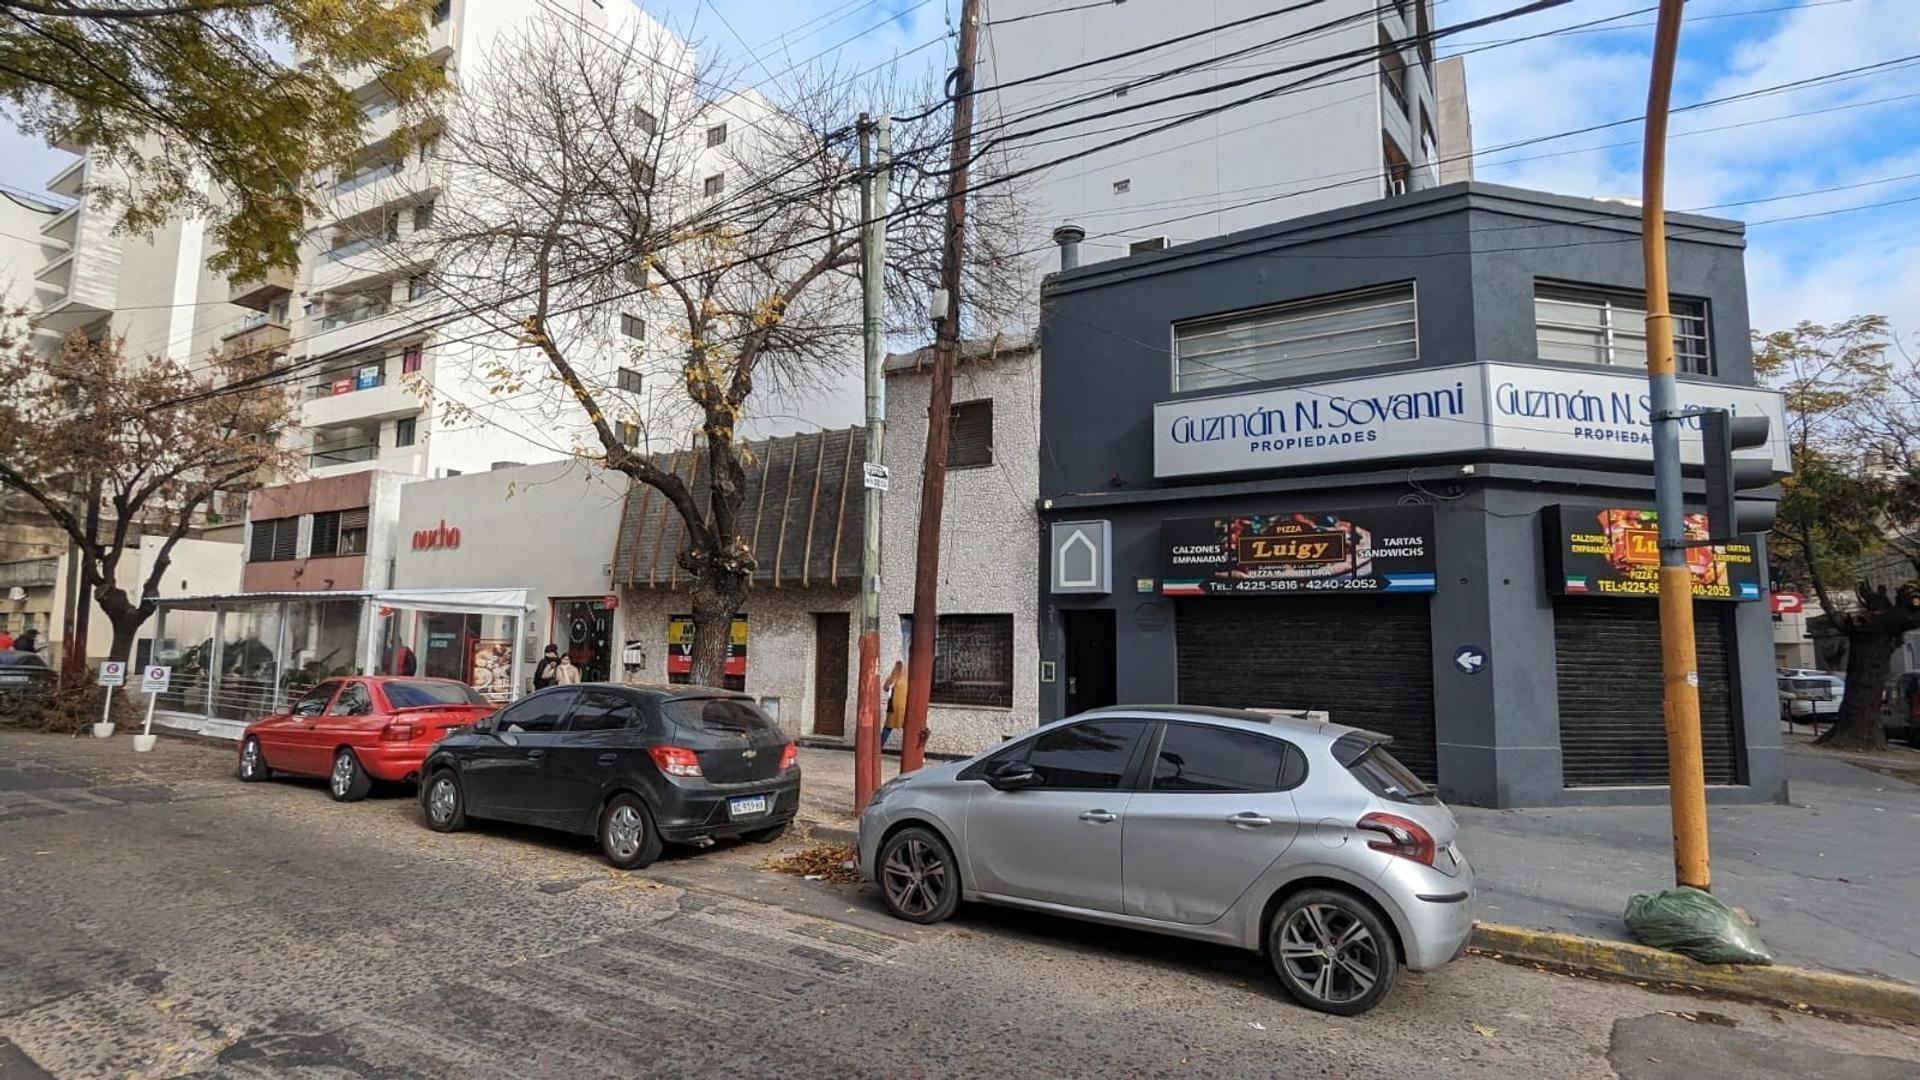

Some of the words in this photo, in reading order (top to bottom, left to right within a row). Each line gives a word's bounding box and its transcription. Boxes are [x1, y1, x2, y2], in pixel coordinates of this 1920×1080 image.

[1495, 382, 1606, 423] Guzmán
[1611, 391, 1636, 425] N.
[1172, 405, 1286, 445] Guzmán
[1295, 399, 1323, 432] N.
[1328, 381, 1465, 430] Sovanni
[1250, 429, 1378, 453] PROPIEDADES
[1573, 427, 1653, 444] PROPIEDA
[1276, 525, 1302, 534] PIZZA
[1383, 536, 1424, 547] TARTAS
[1172, 544, 1221, 555] CALZONES
[1251, 540, 1329, 560] Luigy
[1357, 547, 1425, 559] SANDWICHS
[1172, 554, 1228, 564] EMPANADAS
[1236, 580, 1298, 591] 4225-5816
[1305, 579, 1378, 590] 4240-2052
